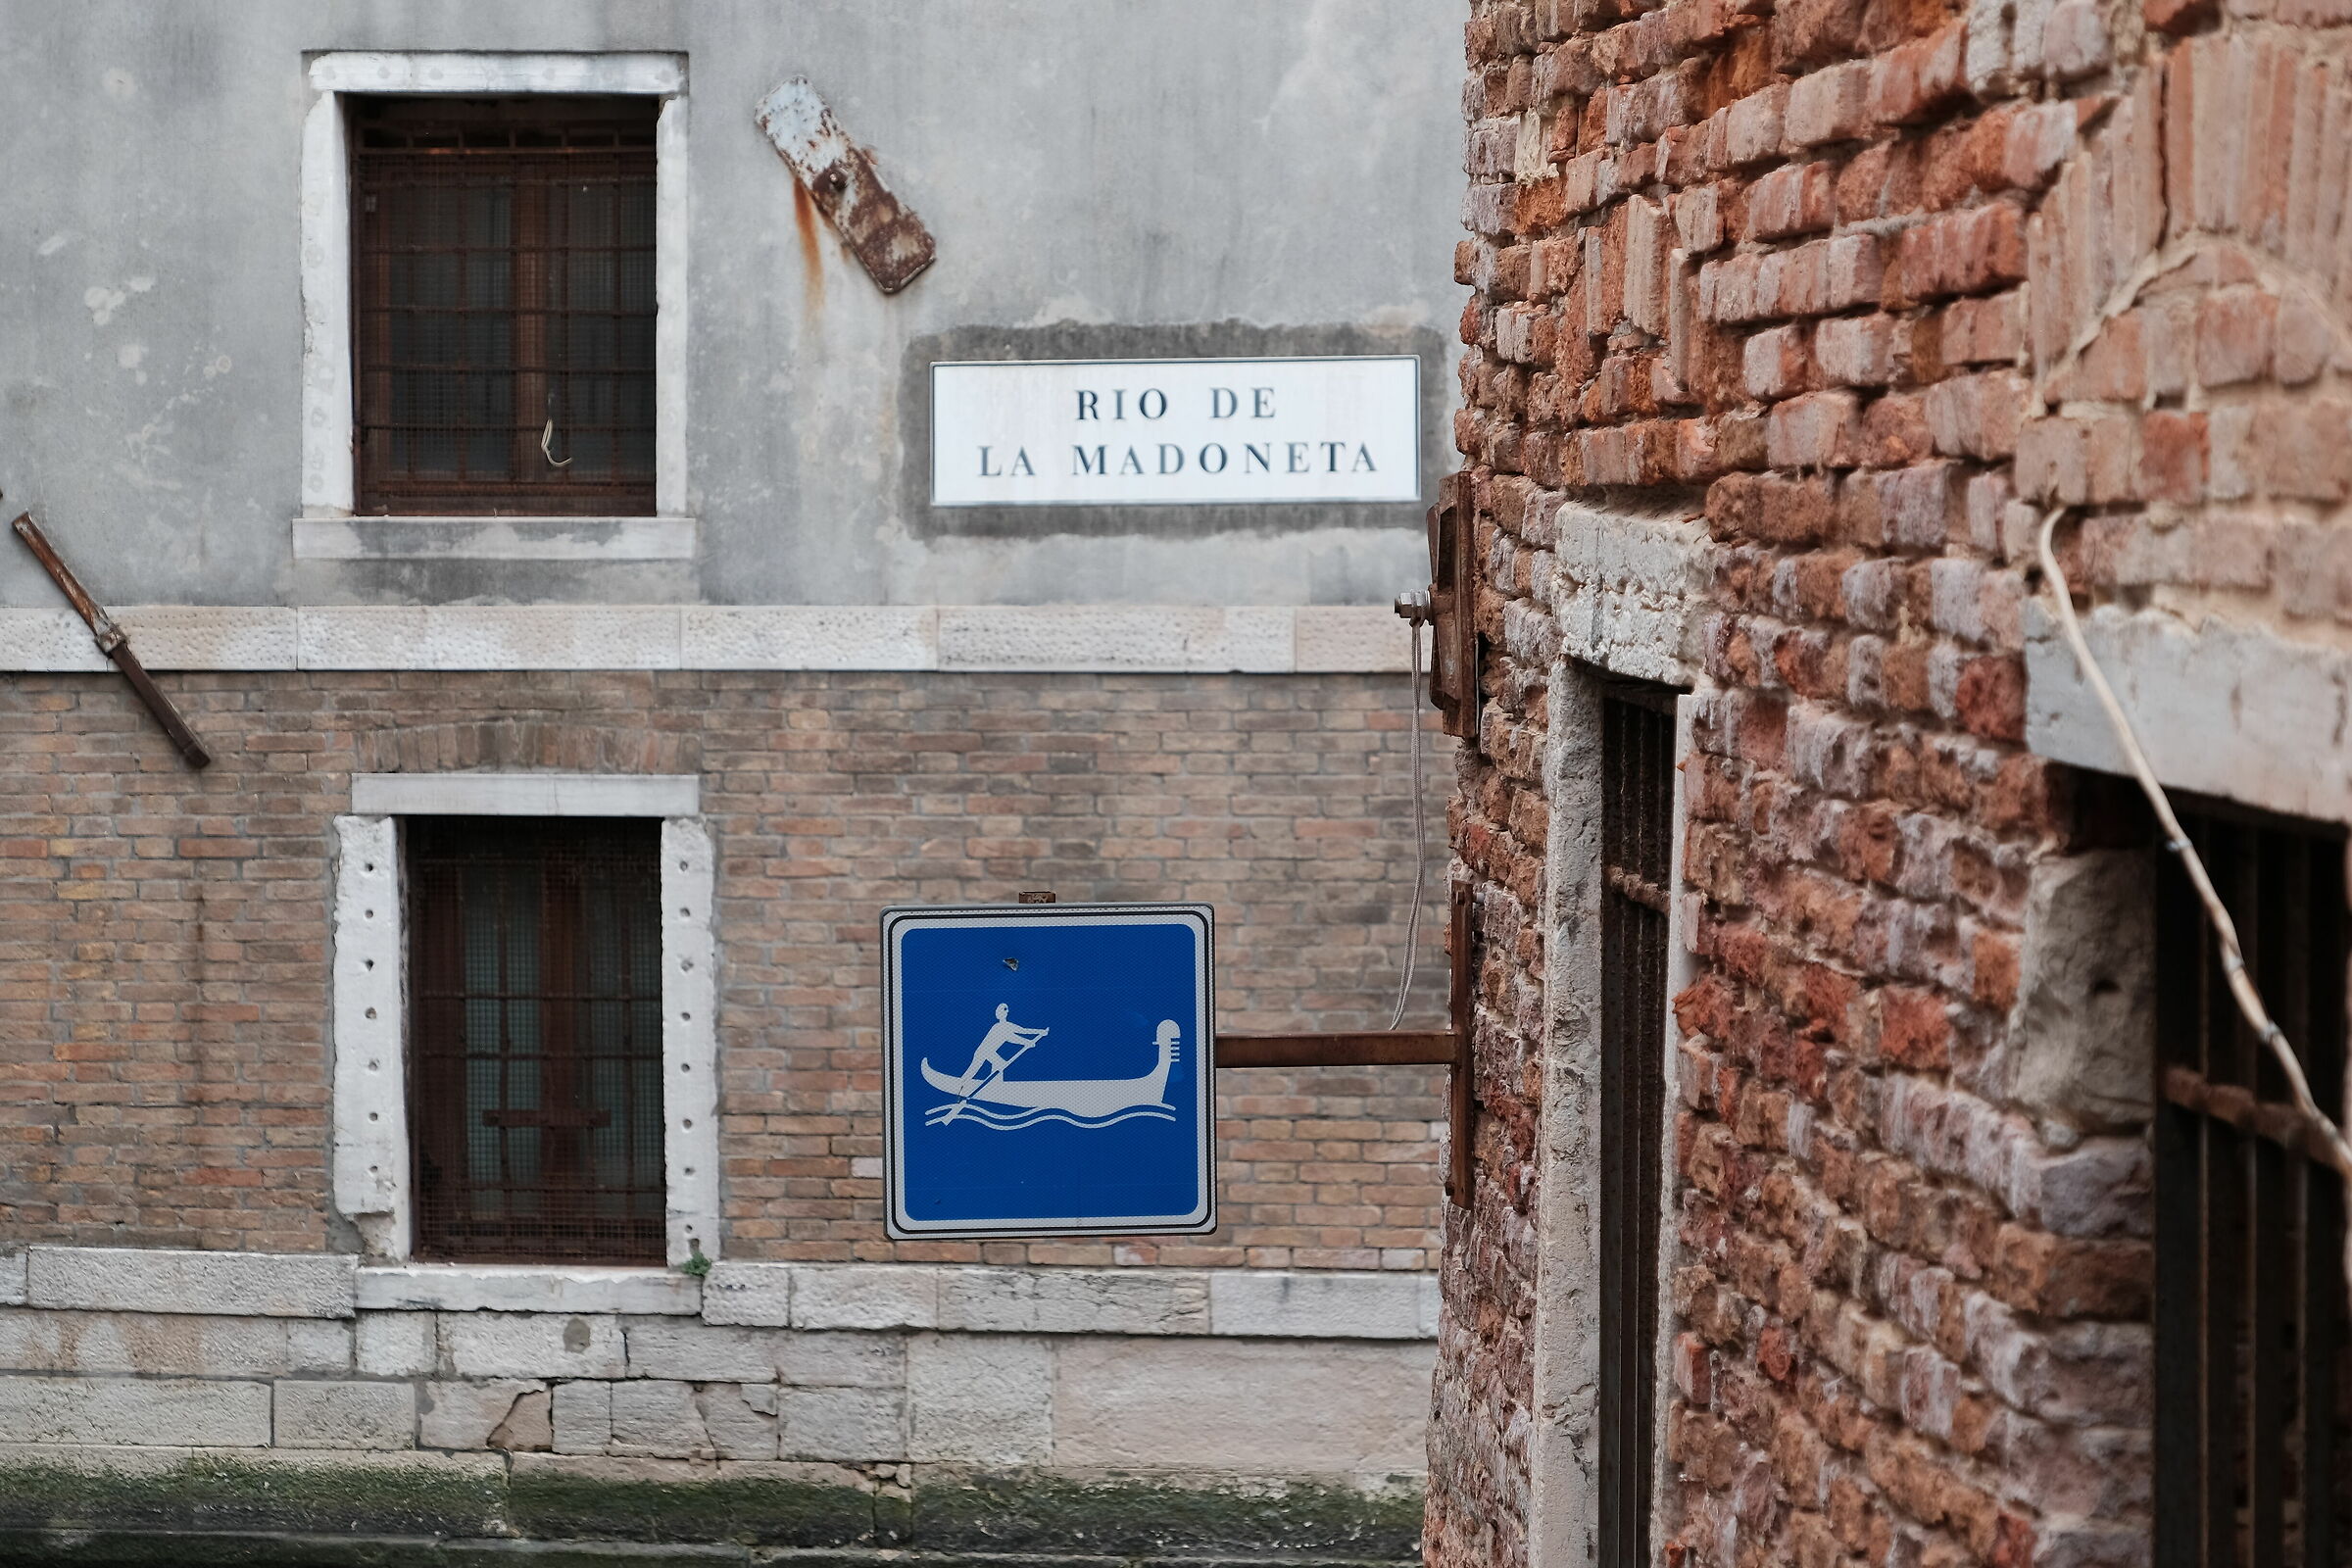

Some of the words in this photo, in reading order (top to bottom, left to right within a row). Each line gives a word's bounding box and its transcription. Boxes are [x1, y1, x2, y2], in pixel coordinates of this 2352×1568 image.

[1077, 388, 1168, 420] RIO
[1210, 387, 1275, 419] DE
[979, 445, 1036, 477] LA
[1072, 442, 1378, 476] MADONETA
